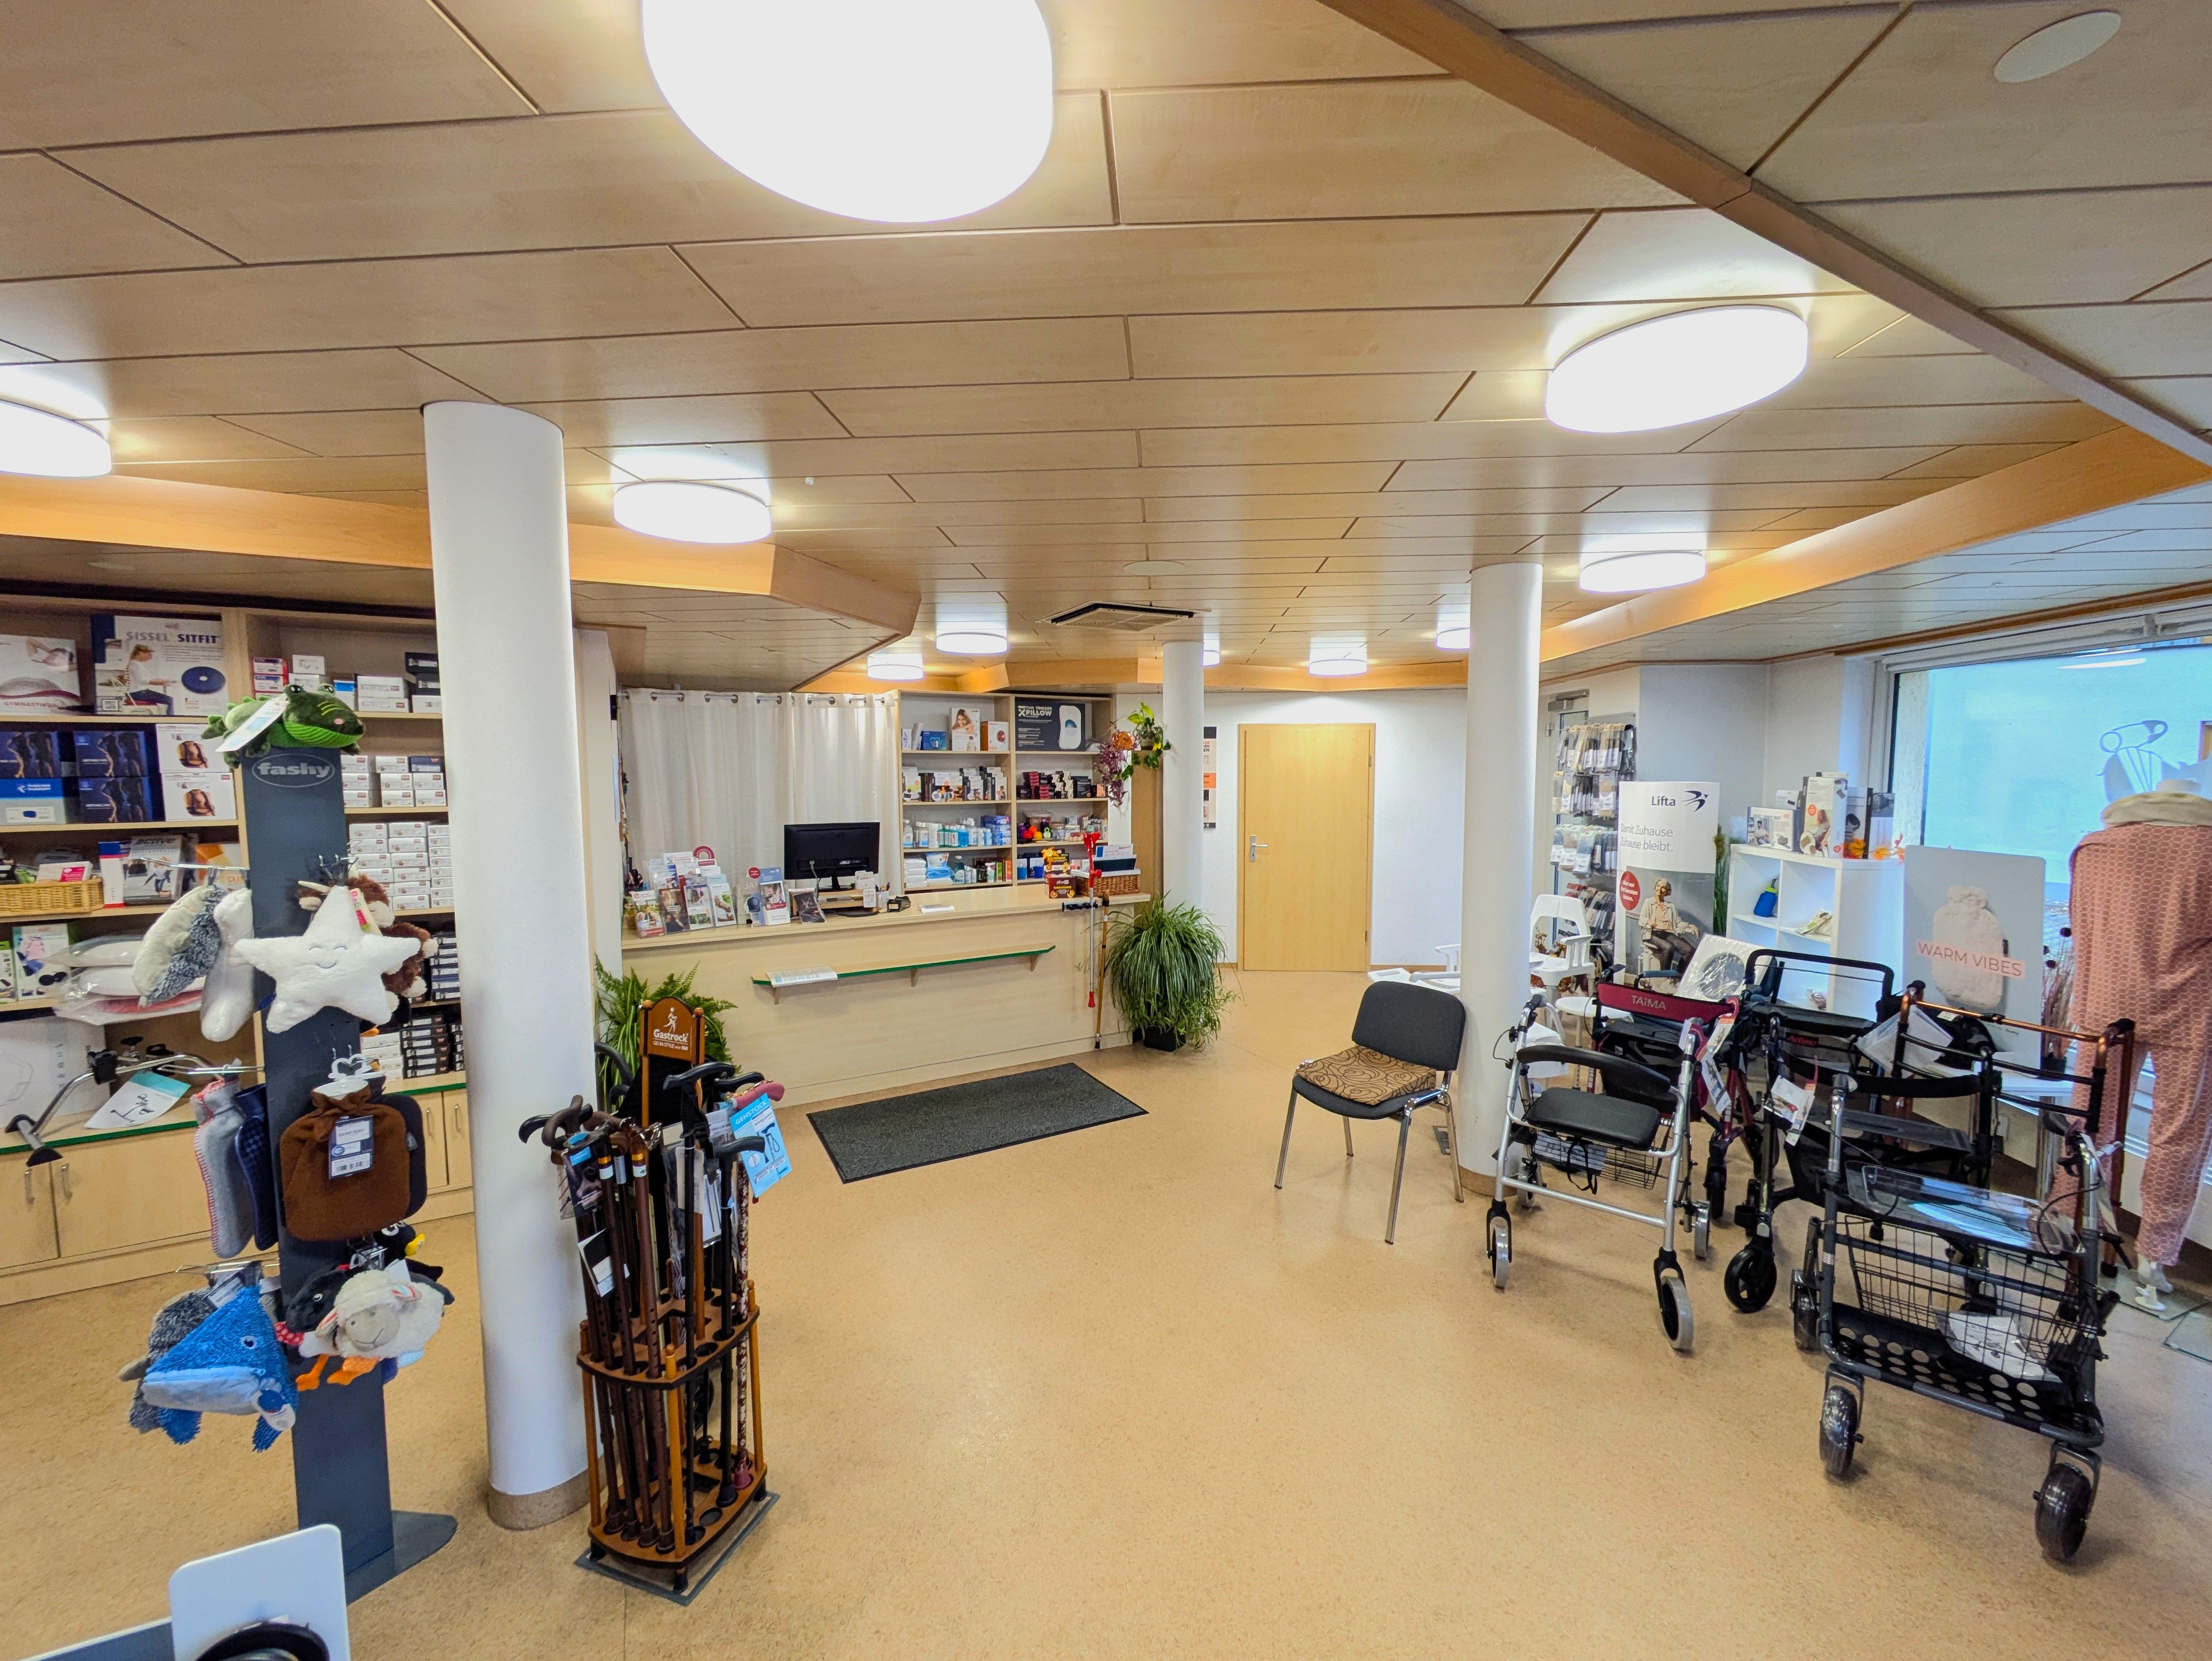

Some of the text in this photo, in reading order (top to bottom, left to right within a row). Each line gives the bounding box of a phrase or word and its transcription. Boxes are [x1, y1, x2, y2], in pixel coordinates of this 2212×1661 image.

[126, 631, 219, 643] SISSEL SITFIT
[258, 762, 331, 778] fashy
[1651, 795, 1676, 806] Lifta
[1635, 825, 1673, 837] Zuhause
[1643, 840, 1673, 852] bleibt.
[1918, 941, 2022, 976] WARM VIBES
[653, 1029, 688, 1043] Gastrock
